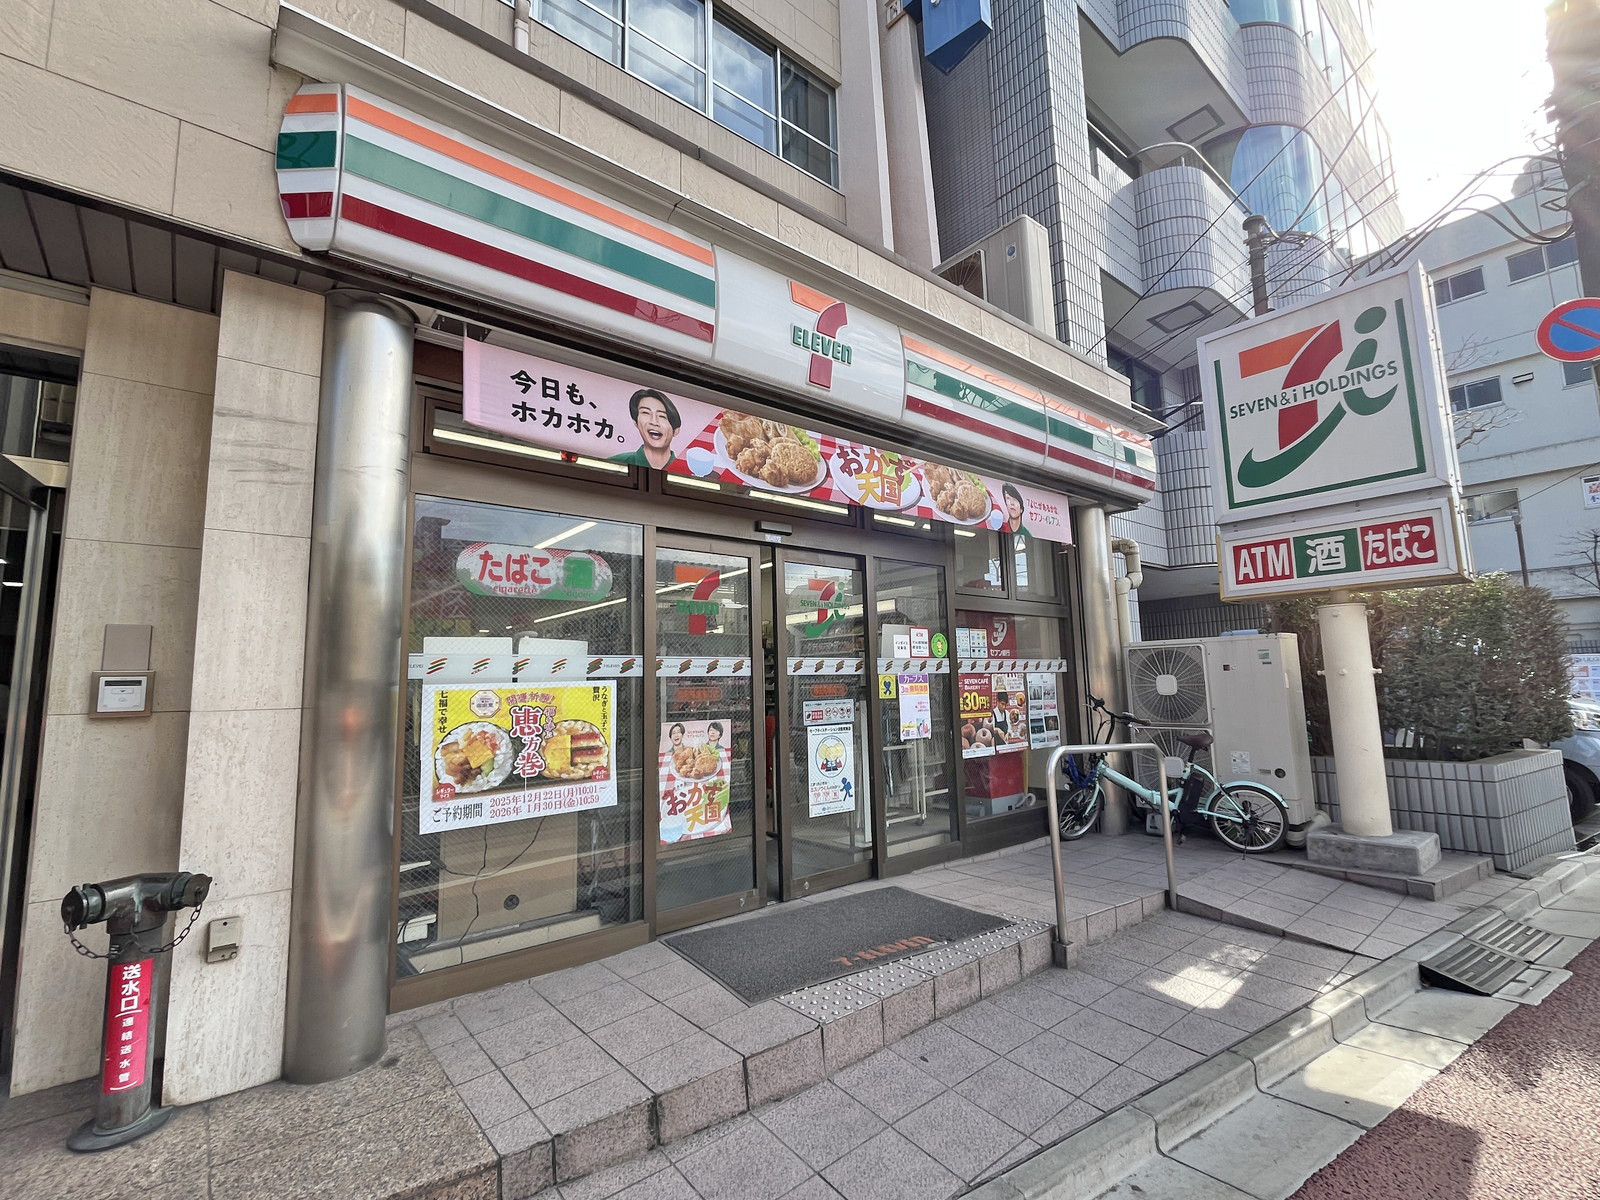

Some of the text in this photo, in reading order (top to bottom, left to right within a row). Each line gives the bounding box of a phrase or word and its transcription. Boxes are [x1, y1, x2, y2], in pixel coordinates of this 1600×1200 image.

[510, 369, 598, 410] 今日も、
[1302, 360, 1399, 400] HOLDINGS
[511, 400, 626, 444] ホカホカ。
[836, 445, 916, 487] おかず
[855, 473, 902, 506] 天国
[1238, 543, 1291, 581] ATM
[1306, 534, 1347, 574] 酒
[1364, 522, 1435, 566] たばこ
[478, 550, 552, 585] たばこ
[437, 690, 449, 734] 七福で幸せ
[510, 706, 545, 778] 恵方巻
[432, 802, 483, 823] ご予約期間
[662, 781, 725, 816] おかず
[684, 801, 722, 833] 天国
[120, 963, 142, 1013] 送水口
